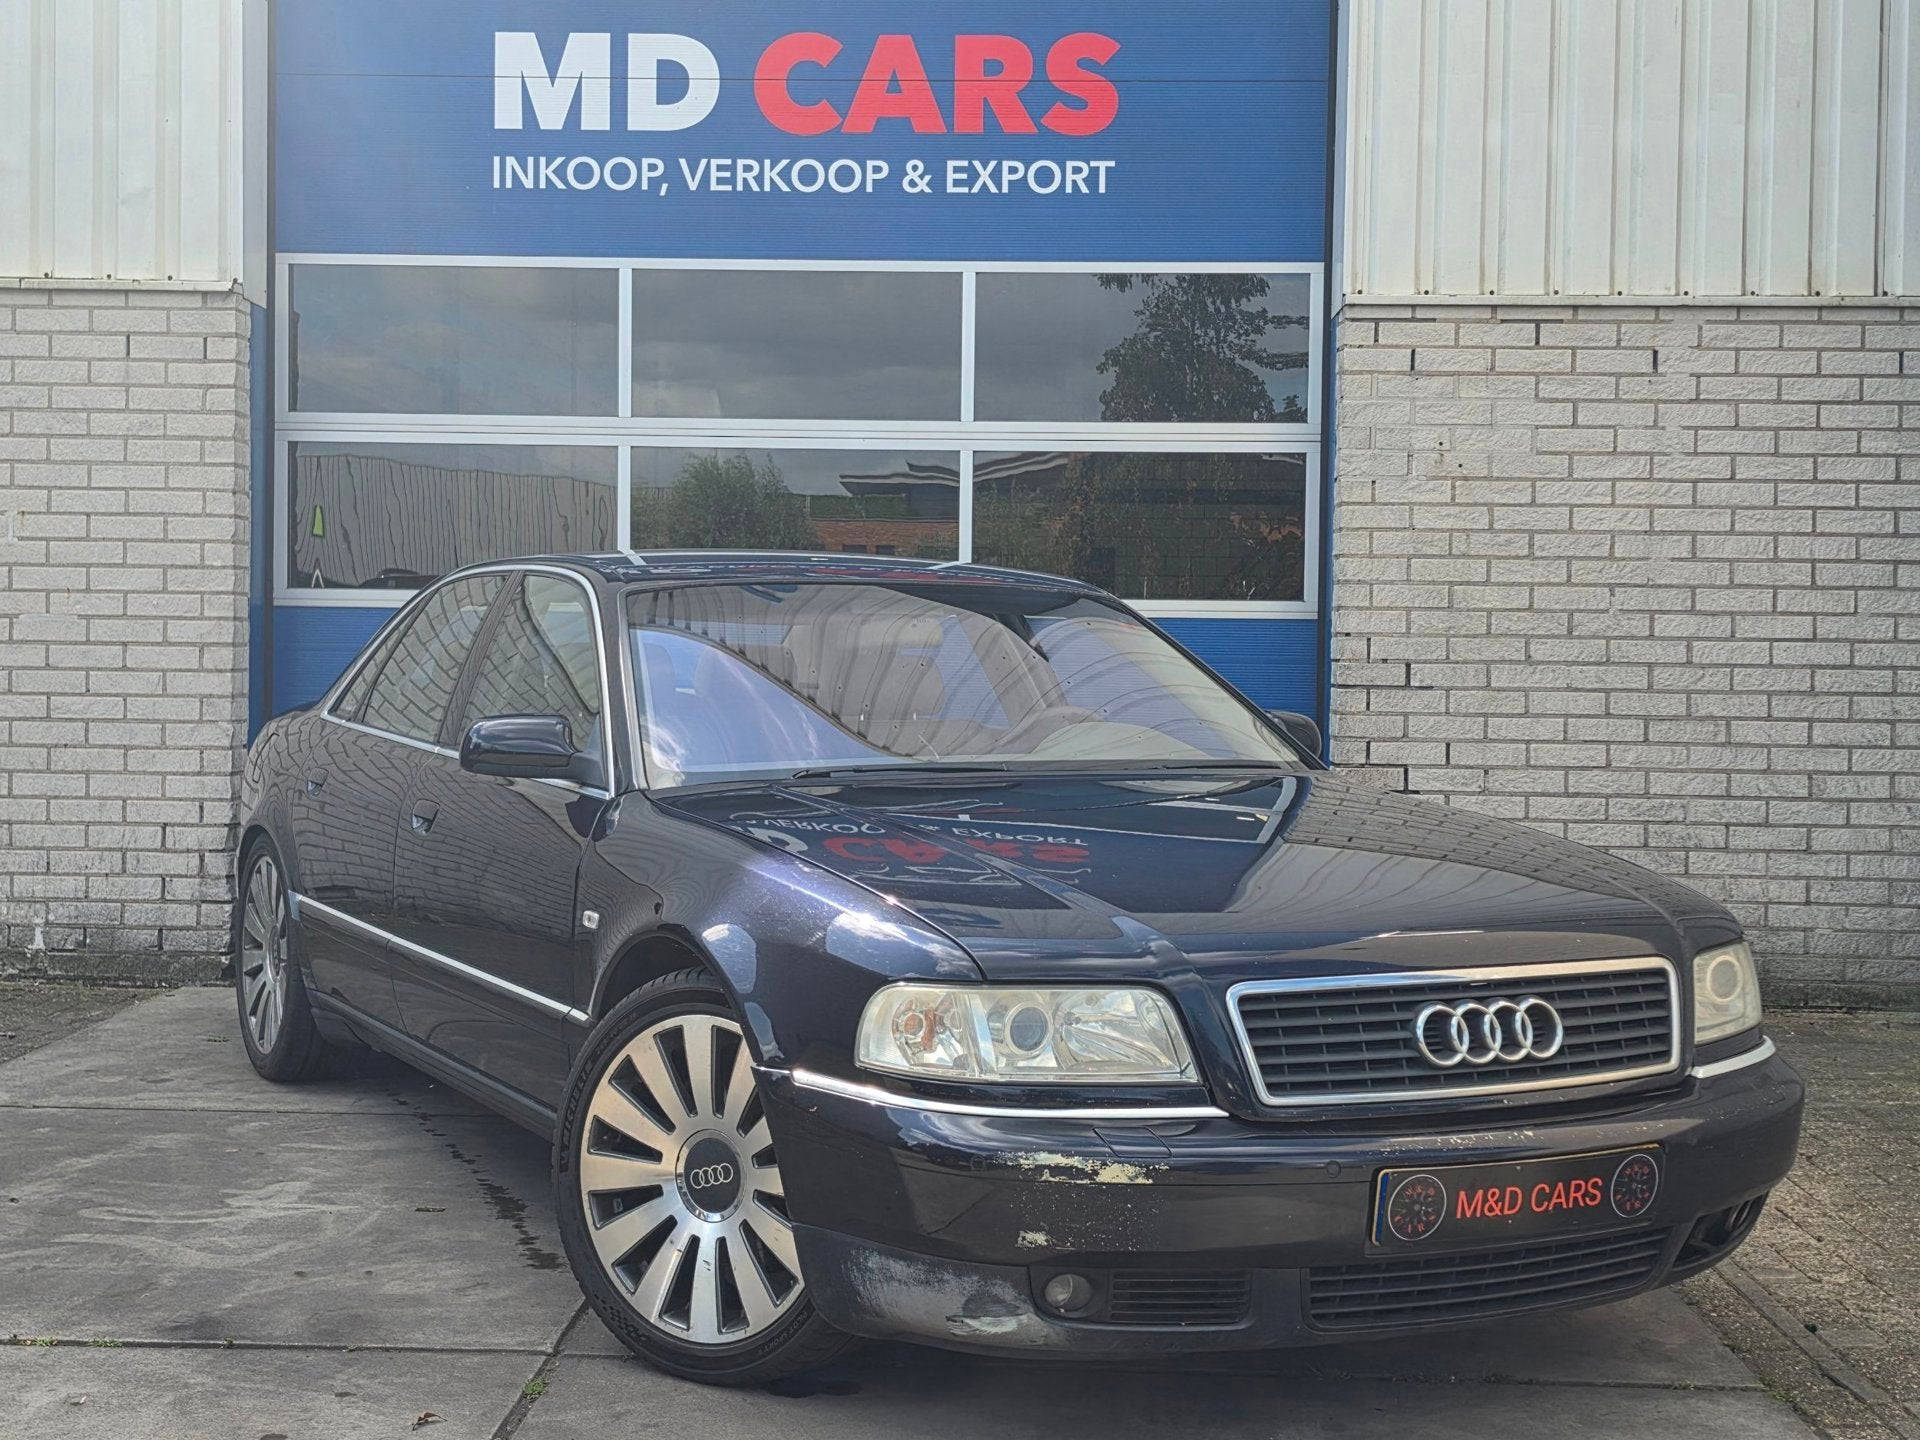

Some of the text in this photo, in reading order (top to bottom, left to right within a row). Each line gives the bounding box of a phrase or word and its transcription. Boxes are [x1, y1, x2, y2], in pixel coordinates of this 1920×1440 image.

[493, 31, 1121, 136] MD CARS
[492, 155, 1116, 197] INKOOP, VERKOOP & EXPORT
[1456, 1184, 1523, 1220] M&D
[1531, 1177, 1604, 1213] CARS
